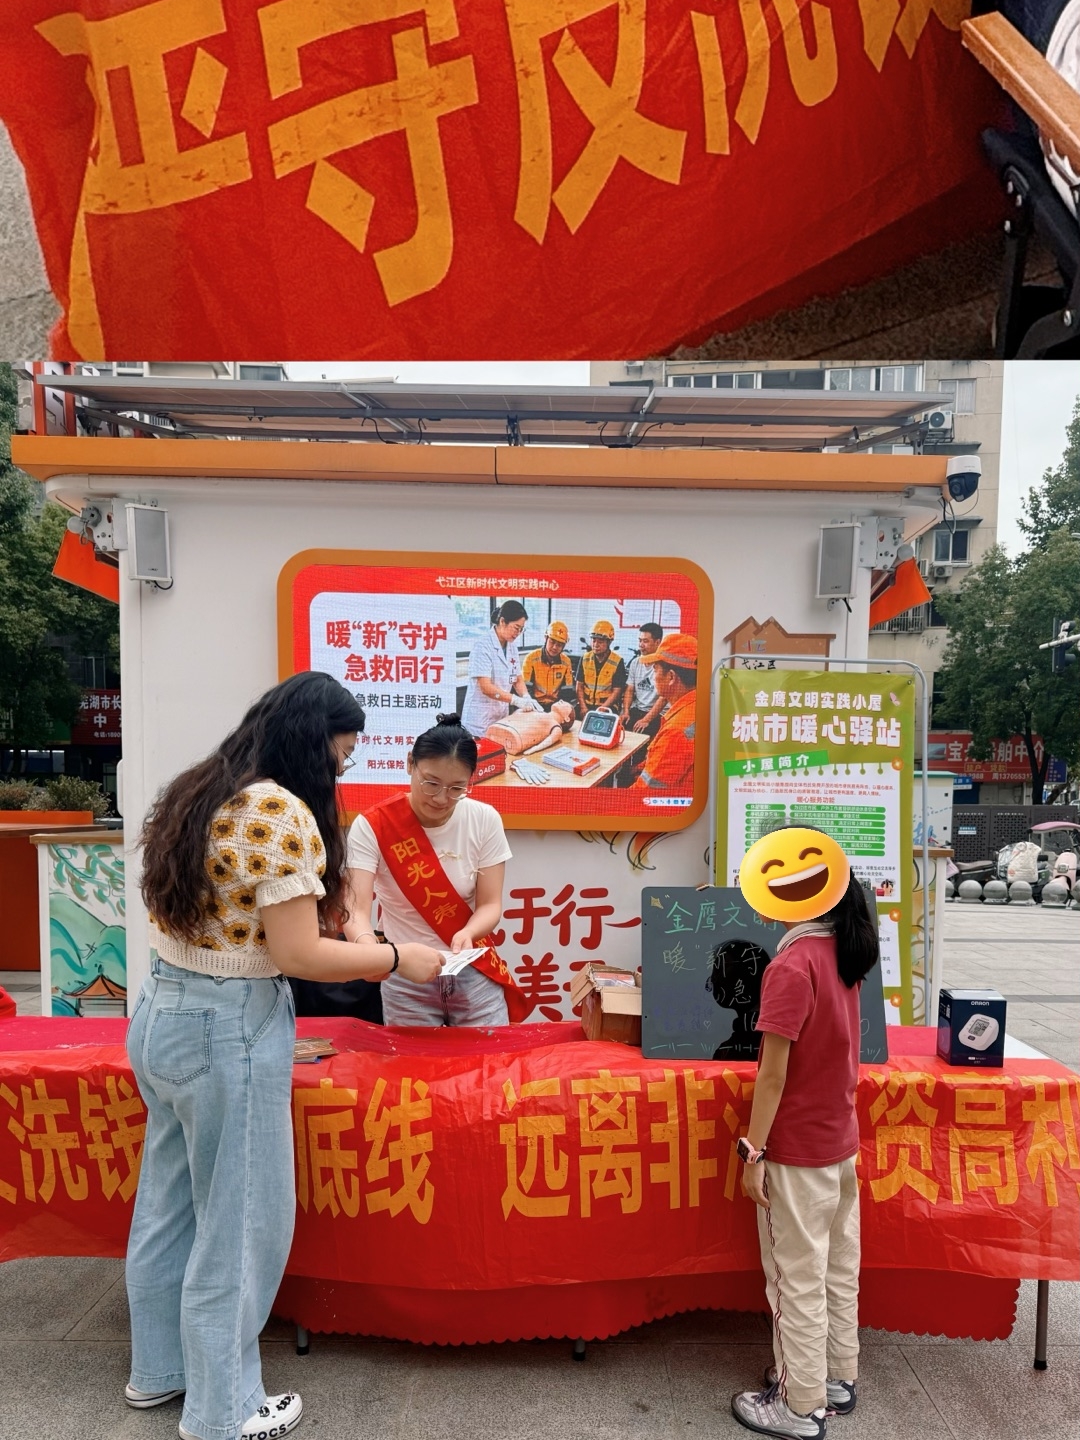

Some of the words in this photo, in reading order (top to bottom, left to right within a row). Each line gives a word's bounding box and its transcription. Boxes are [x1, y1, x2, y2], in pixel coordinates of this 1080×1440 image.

[435, 575, 560, 591] 弋江区新时代文明实践中心
[326, 619, 448, 651] 暖“新”守护
[343, 654, 445, 684] 急救同行
[754, 690, 882, 711] 金鹰文明实践小屋
[93, 712, 107, 729] 中
[732, 713, 902, 748] 城市暖心驿站
[366, 759, 406, 770] 阳光保险
[484, 763, 496, 774] AED
[742, 753, 810, 773] 小屋简介
[796, 796, 836, 804] 暖心服务功能
[390, 836, 458, 925] 阳光人寿
[489, 883, 615, 951] 于行
[0, 1075, 147, 1206] 洗钱
[855, 1068, 1080, 1208] 资高利
[241, 1423, 287, 1440] crocs
